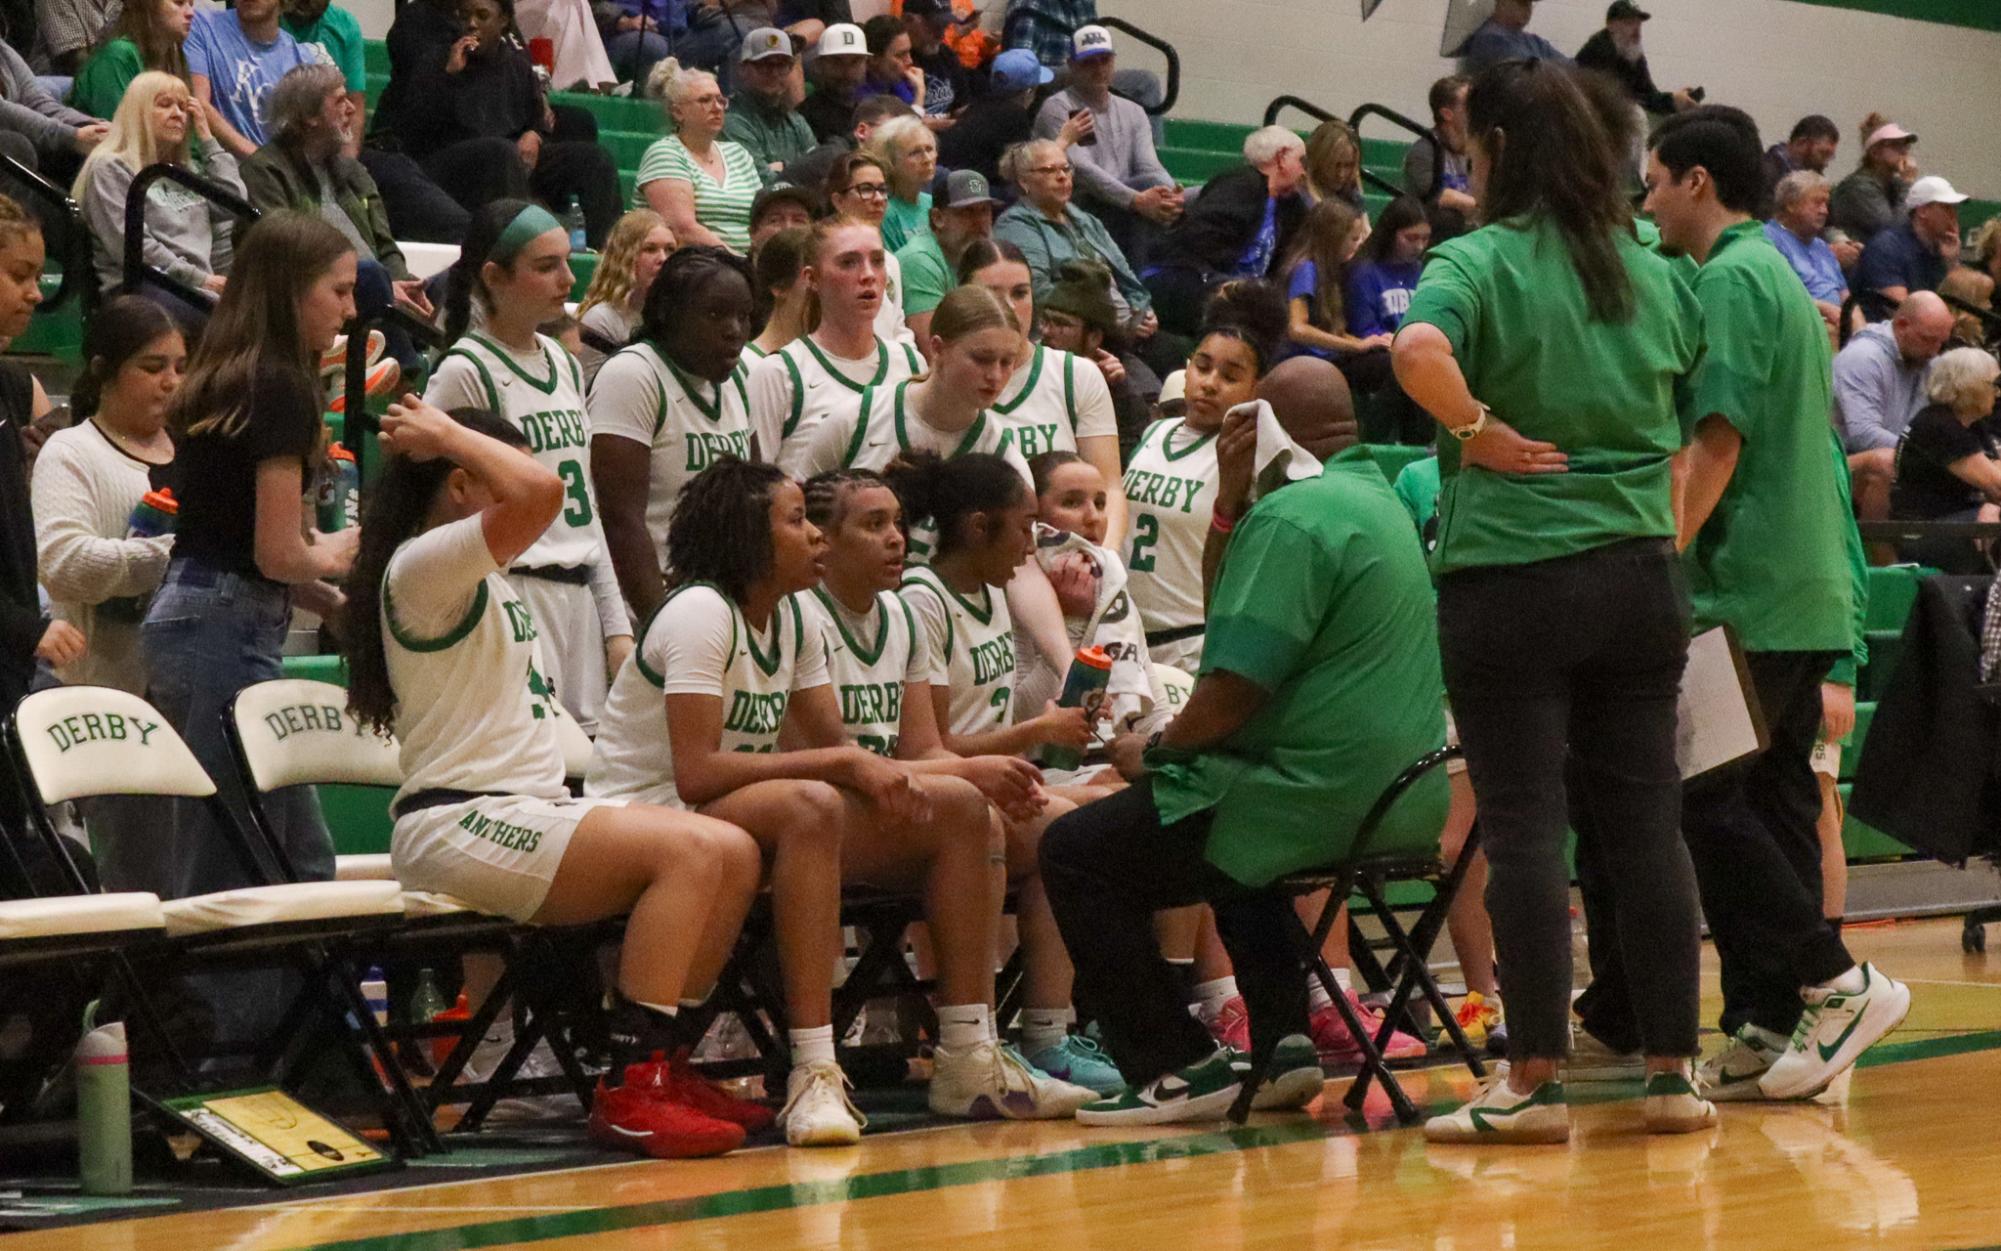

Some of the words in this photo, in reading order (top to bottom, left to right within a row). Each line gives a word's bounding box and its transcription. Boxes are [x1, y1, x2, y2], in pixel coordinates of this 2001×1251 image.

[842, 31, 855, 45] D
[519, 409, 586, 454] DERB
[558, 459, 593, 528] 3
[1129, 513, 1159, 572] 2
[46, 713, 159, 752] DERBY
